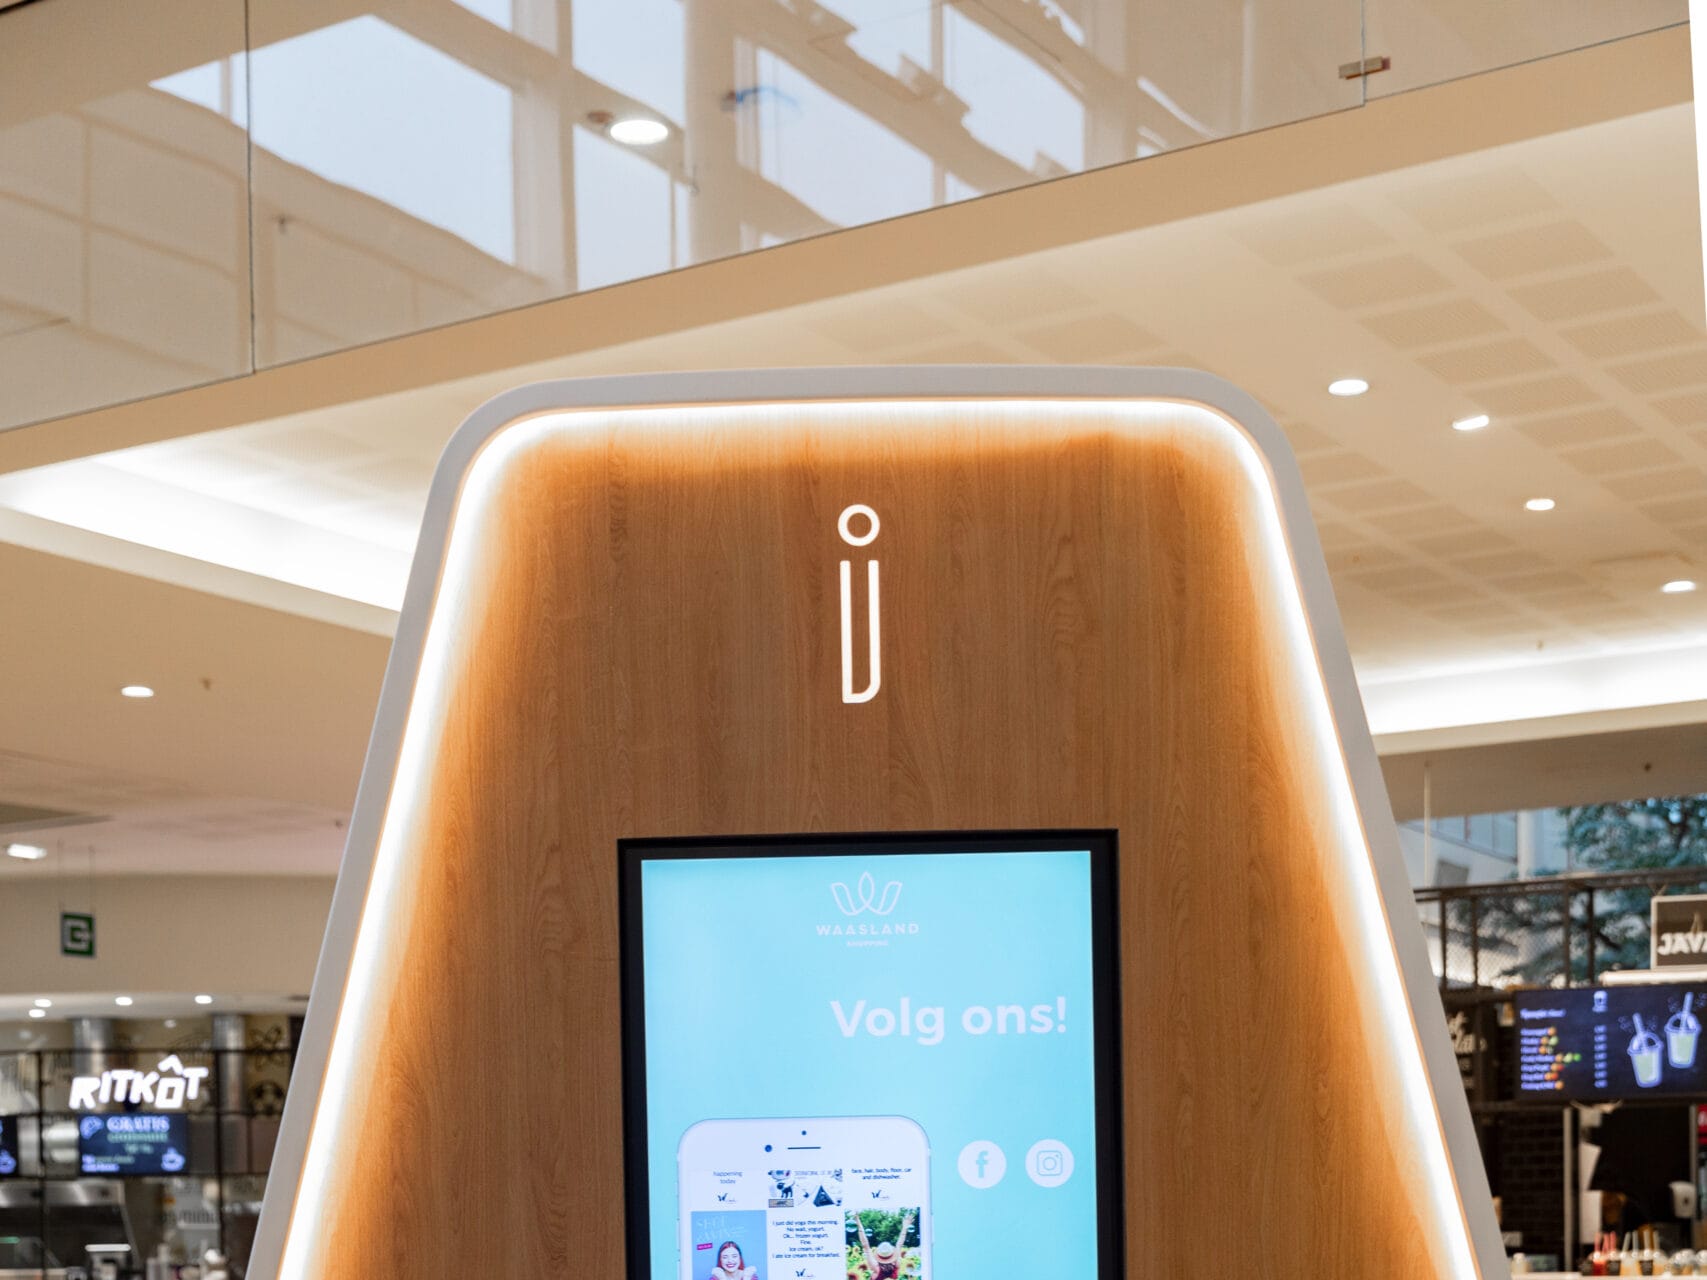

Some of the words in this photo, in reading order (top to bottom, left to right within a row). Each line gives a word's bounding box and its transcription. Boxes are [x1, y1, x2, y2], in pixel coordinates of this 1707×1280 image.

[816, 923, 920, 936] WAASLAND
[830, 997, 945, 1046] Volg
[962, 996, 1067, 1035] ons!
[68, 1054, 209, 1109] RITKÔT
